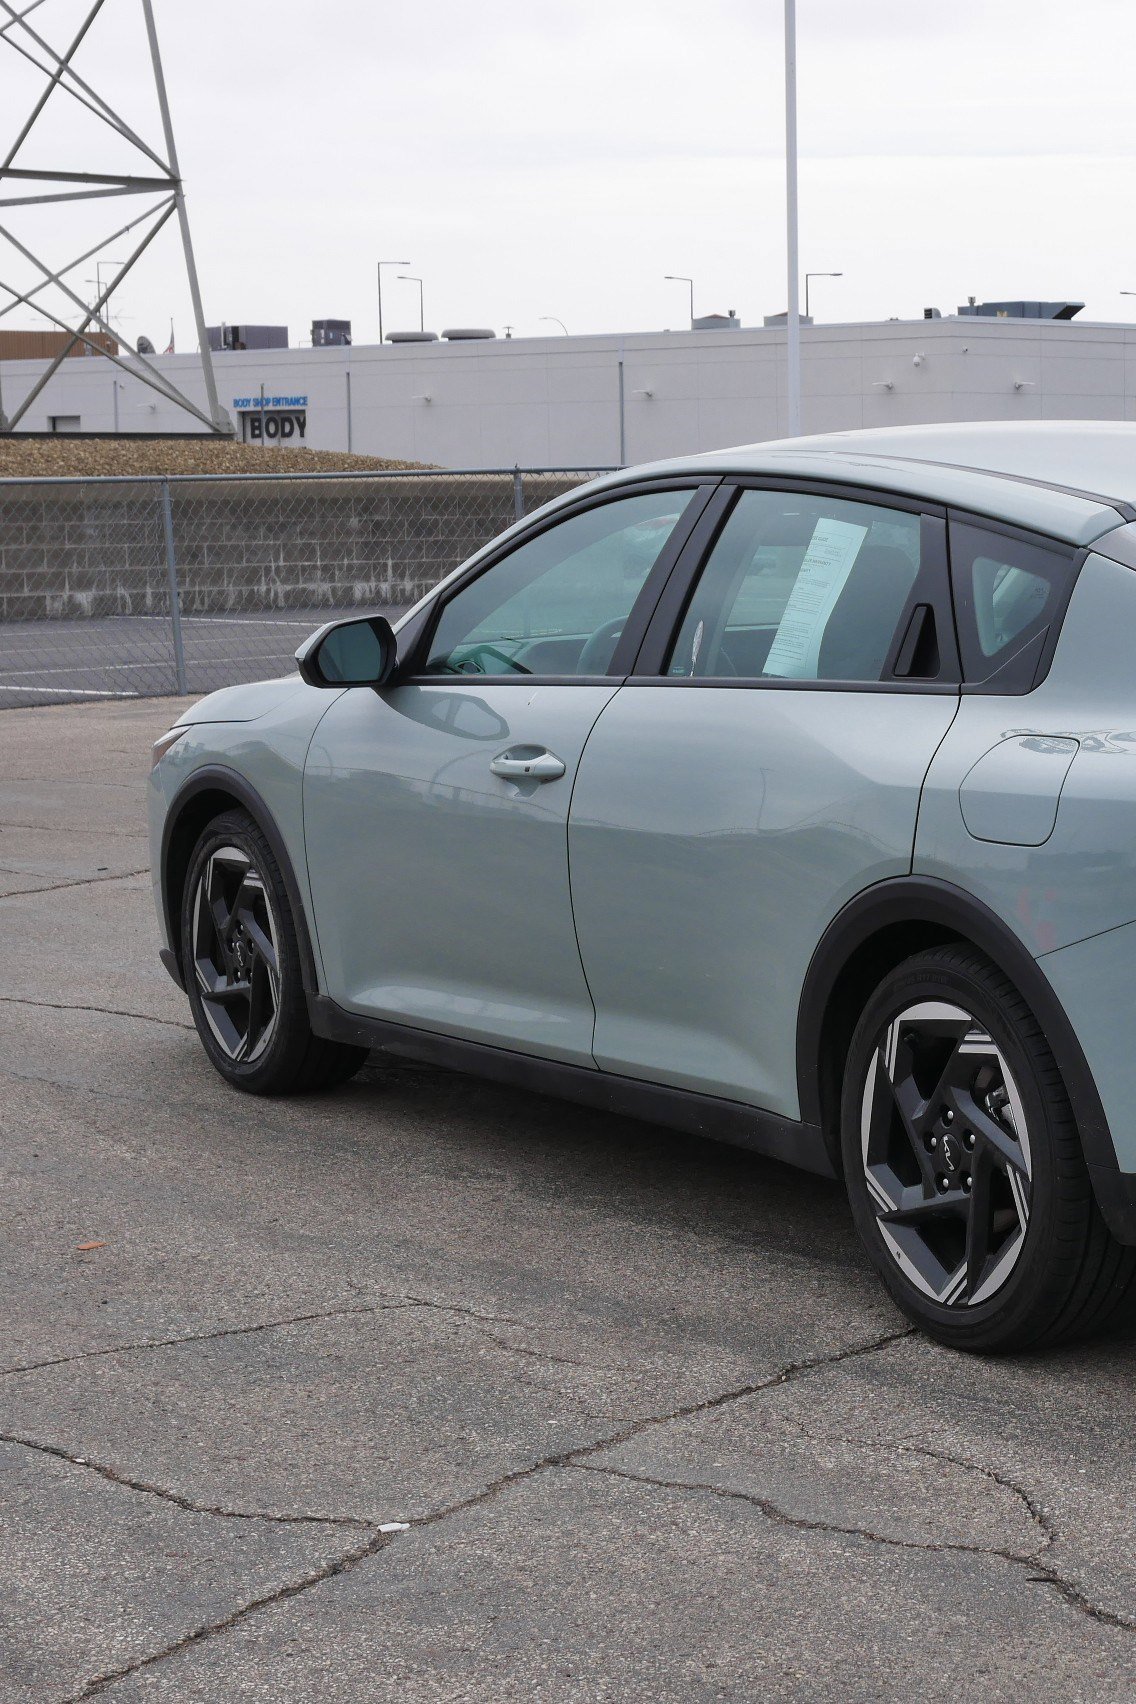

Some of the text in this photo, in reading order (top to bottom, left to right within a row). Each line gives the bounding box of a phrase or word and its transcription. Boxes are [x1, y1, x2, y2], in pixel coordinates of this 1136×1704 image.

[233, 396, 308, 408] BODY SHOP ENTRANCE
[250, 416, 307, 439] BODY
